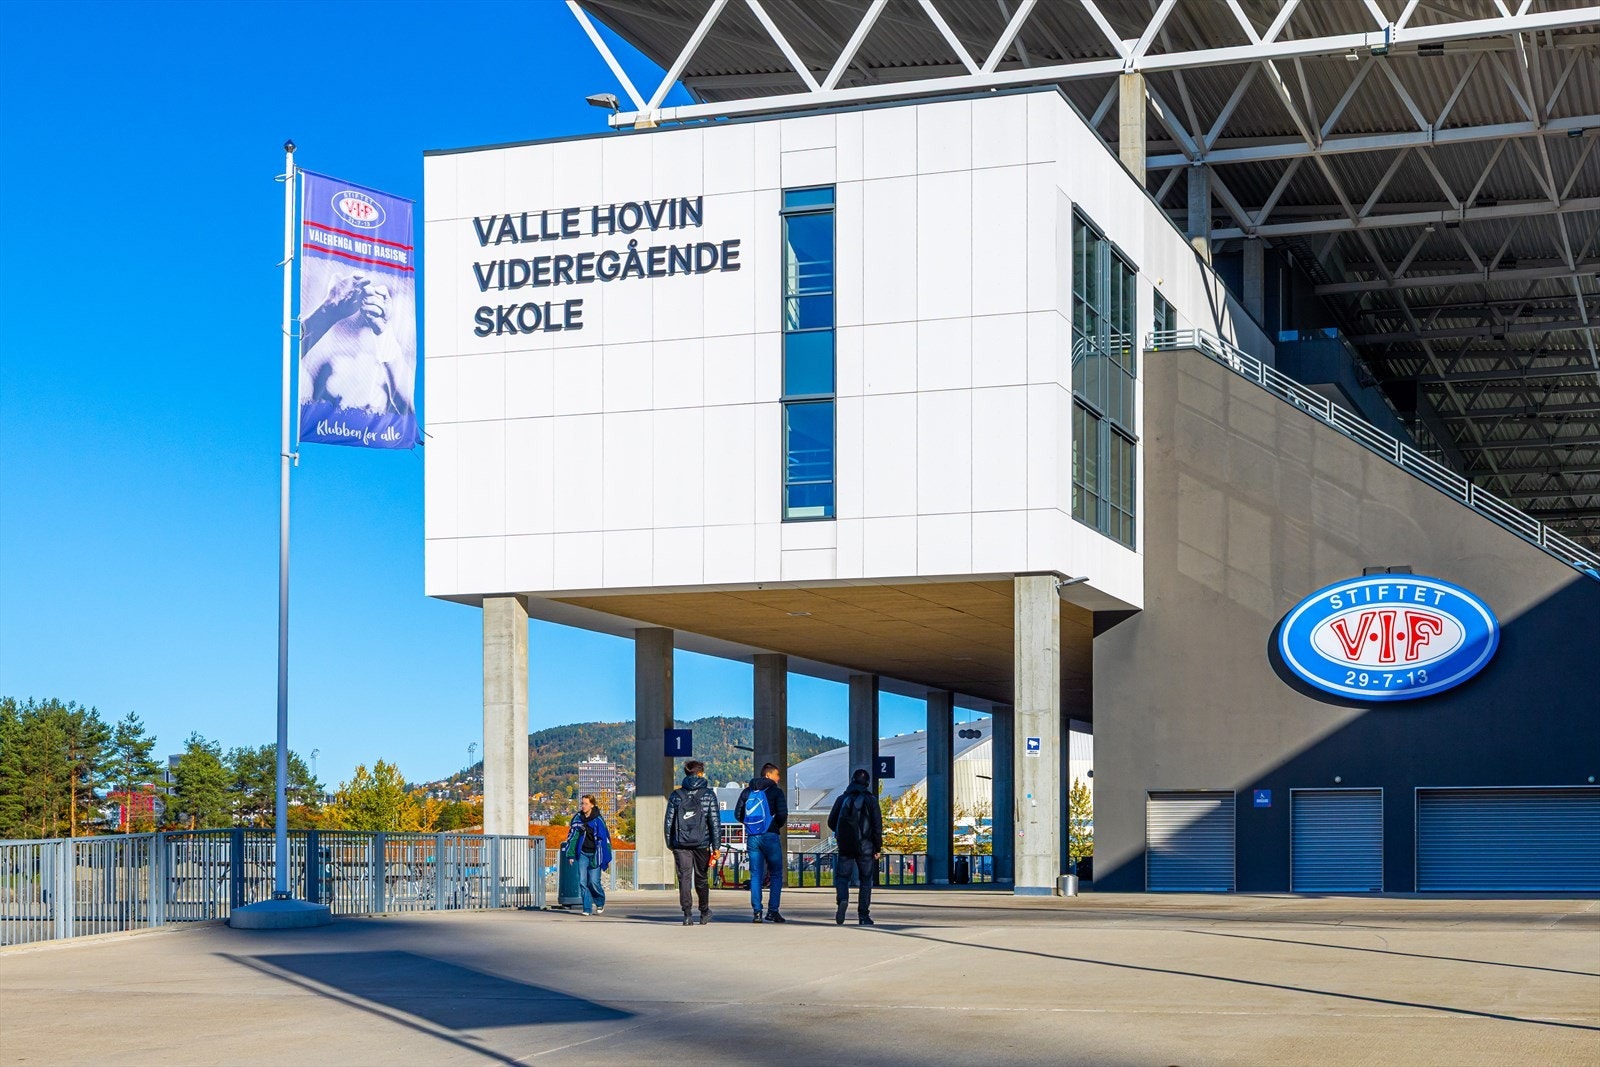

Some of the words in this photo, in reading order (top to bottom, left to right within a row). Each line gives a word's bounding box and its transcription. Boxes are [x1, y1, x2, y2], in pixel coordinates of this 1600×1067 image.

[473, 207, 580, 247] VALLE
[592, 196, 703, 236] HOVIN
[354, 241, 372, 255] MOT
[473, 239, 741, 292] VIDEREGÅENDE
[474, 299, 583, 337] SKOLE
[317, 419, 362, 439] Klubben
[363, 427, 377, 445] for
[381, 426, 401, 441] alle
[1329, 585, 1445, 609] STIFTET
[1345, 669, 1428, 688] 29-7-13
[676, 736, 681, 750] 1
[880, 762, 887, 773] 2
